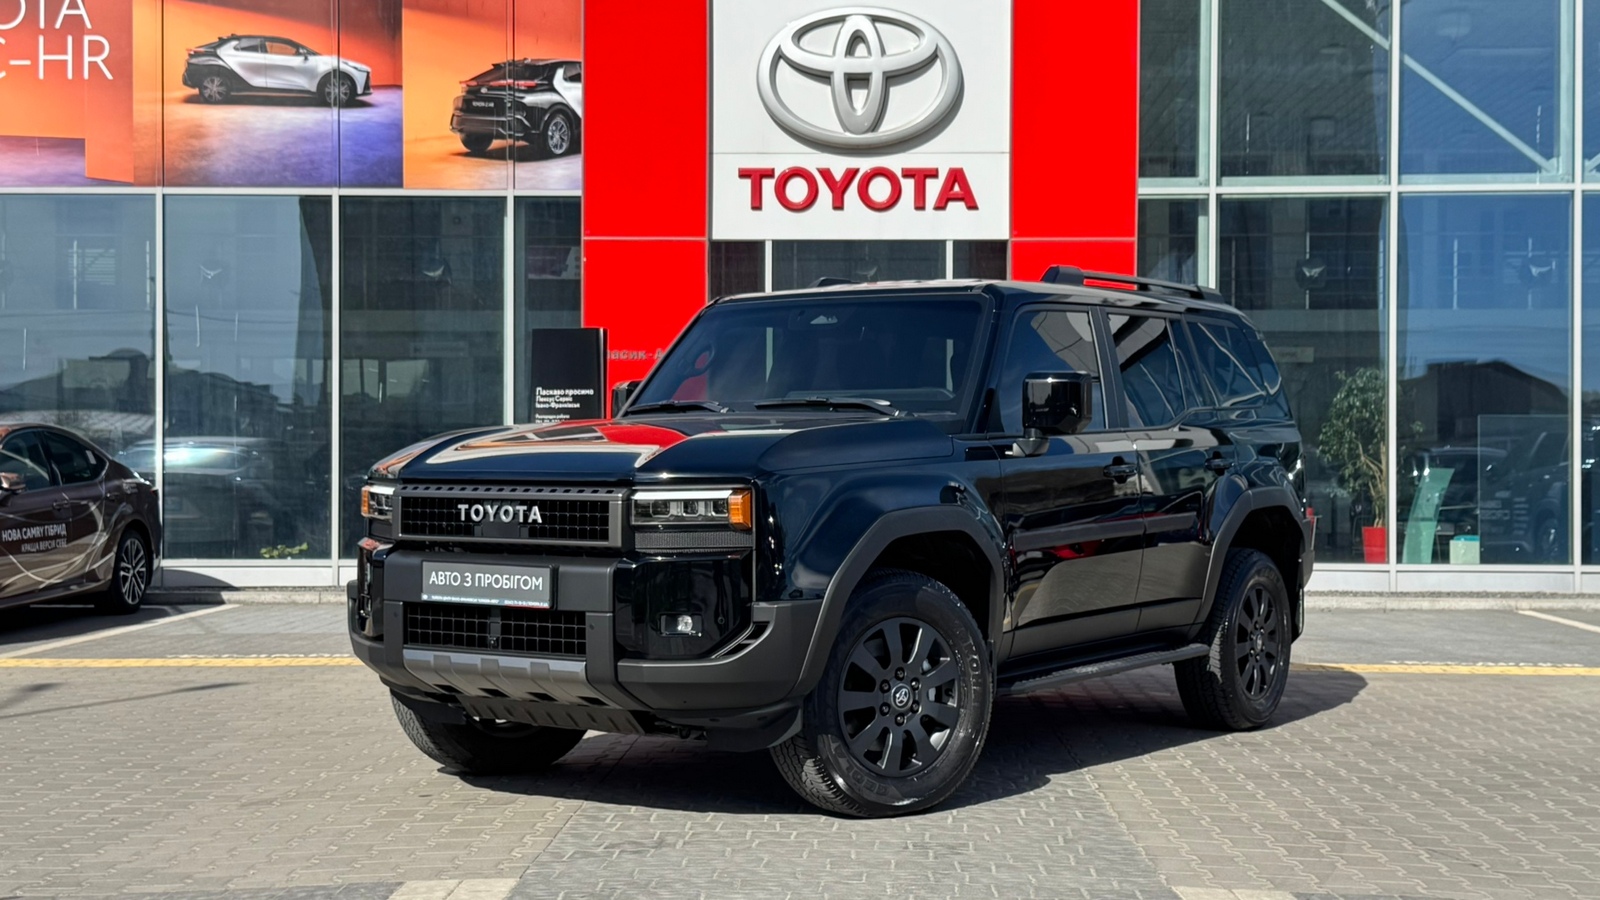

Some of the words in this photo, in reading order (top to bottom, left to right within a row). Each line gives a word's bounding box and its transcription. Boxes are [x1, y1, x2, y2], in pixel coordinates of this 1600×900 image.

[0, 34, 114, 80] -HR
[738, 166, 979, 212] TOYOTA
[457, 504, 543, 523] TOYOTA
[2, 529, 21, 541] НОВА
[429, 571, 461, 586] АВТО
[463, 572, 472, 587] З
[475, 573, 543, 591] ПРОБІГОМ
